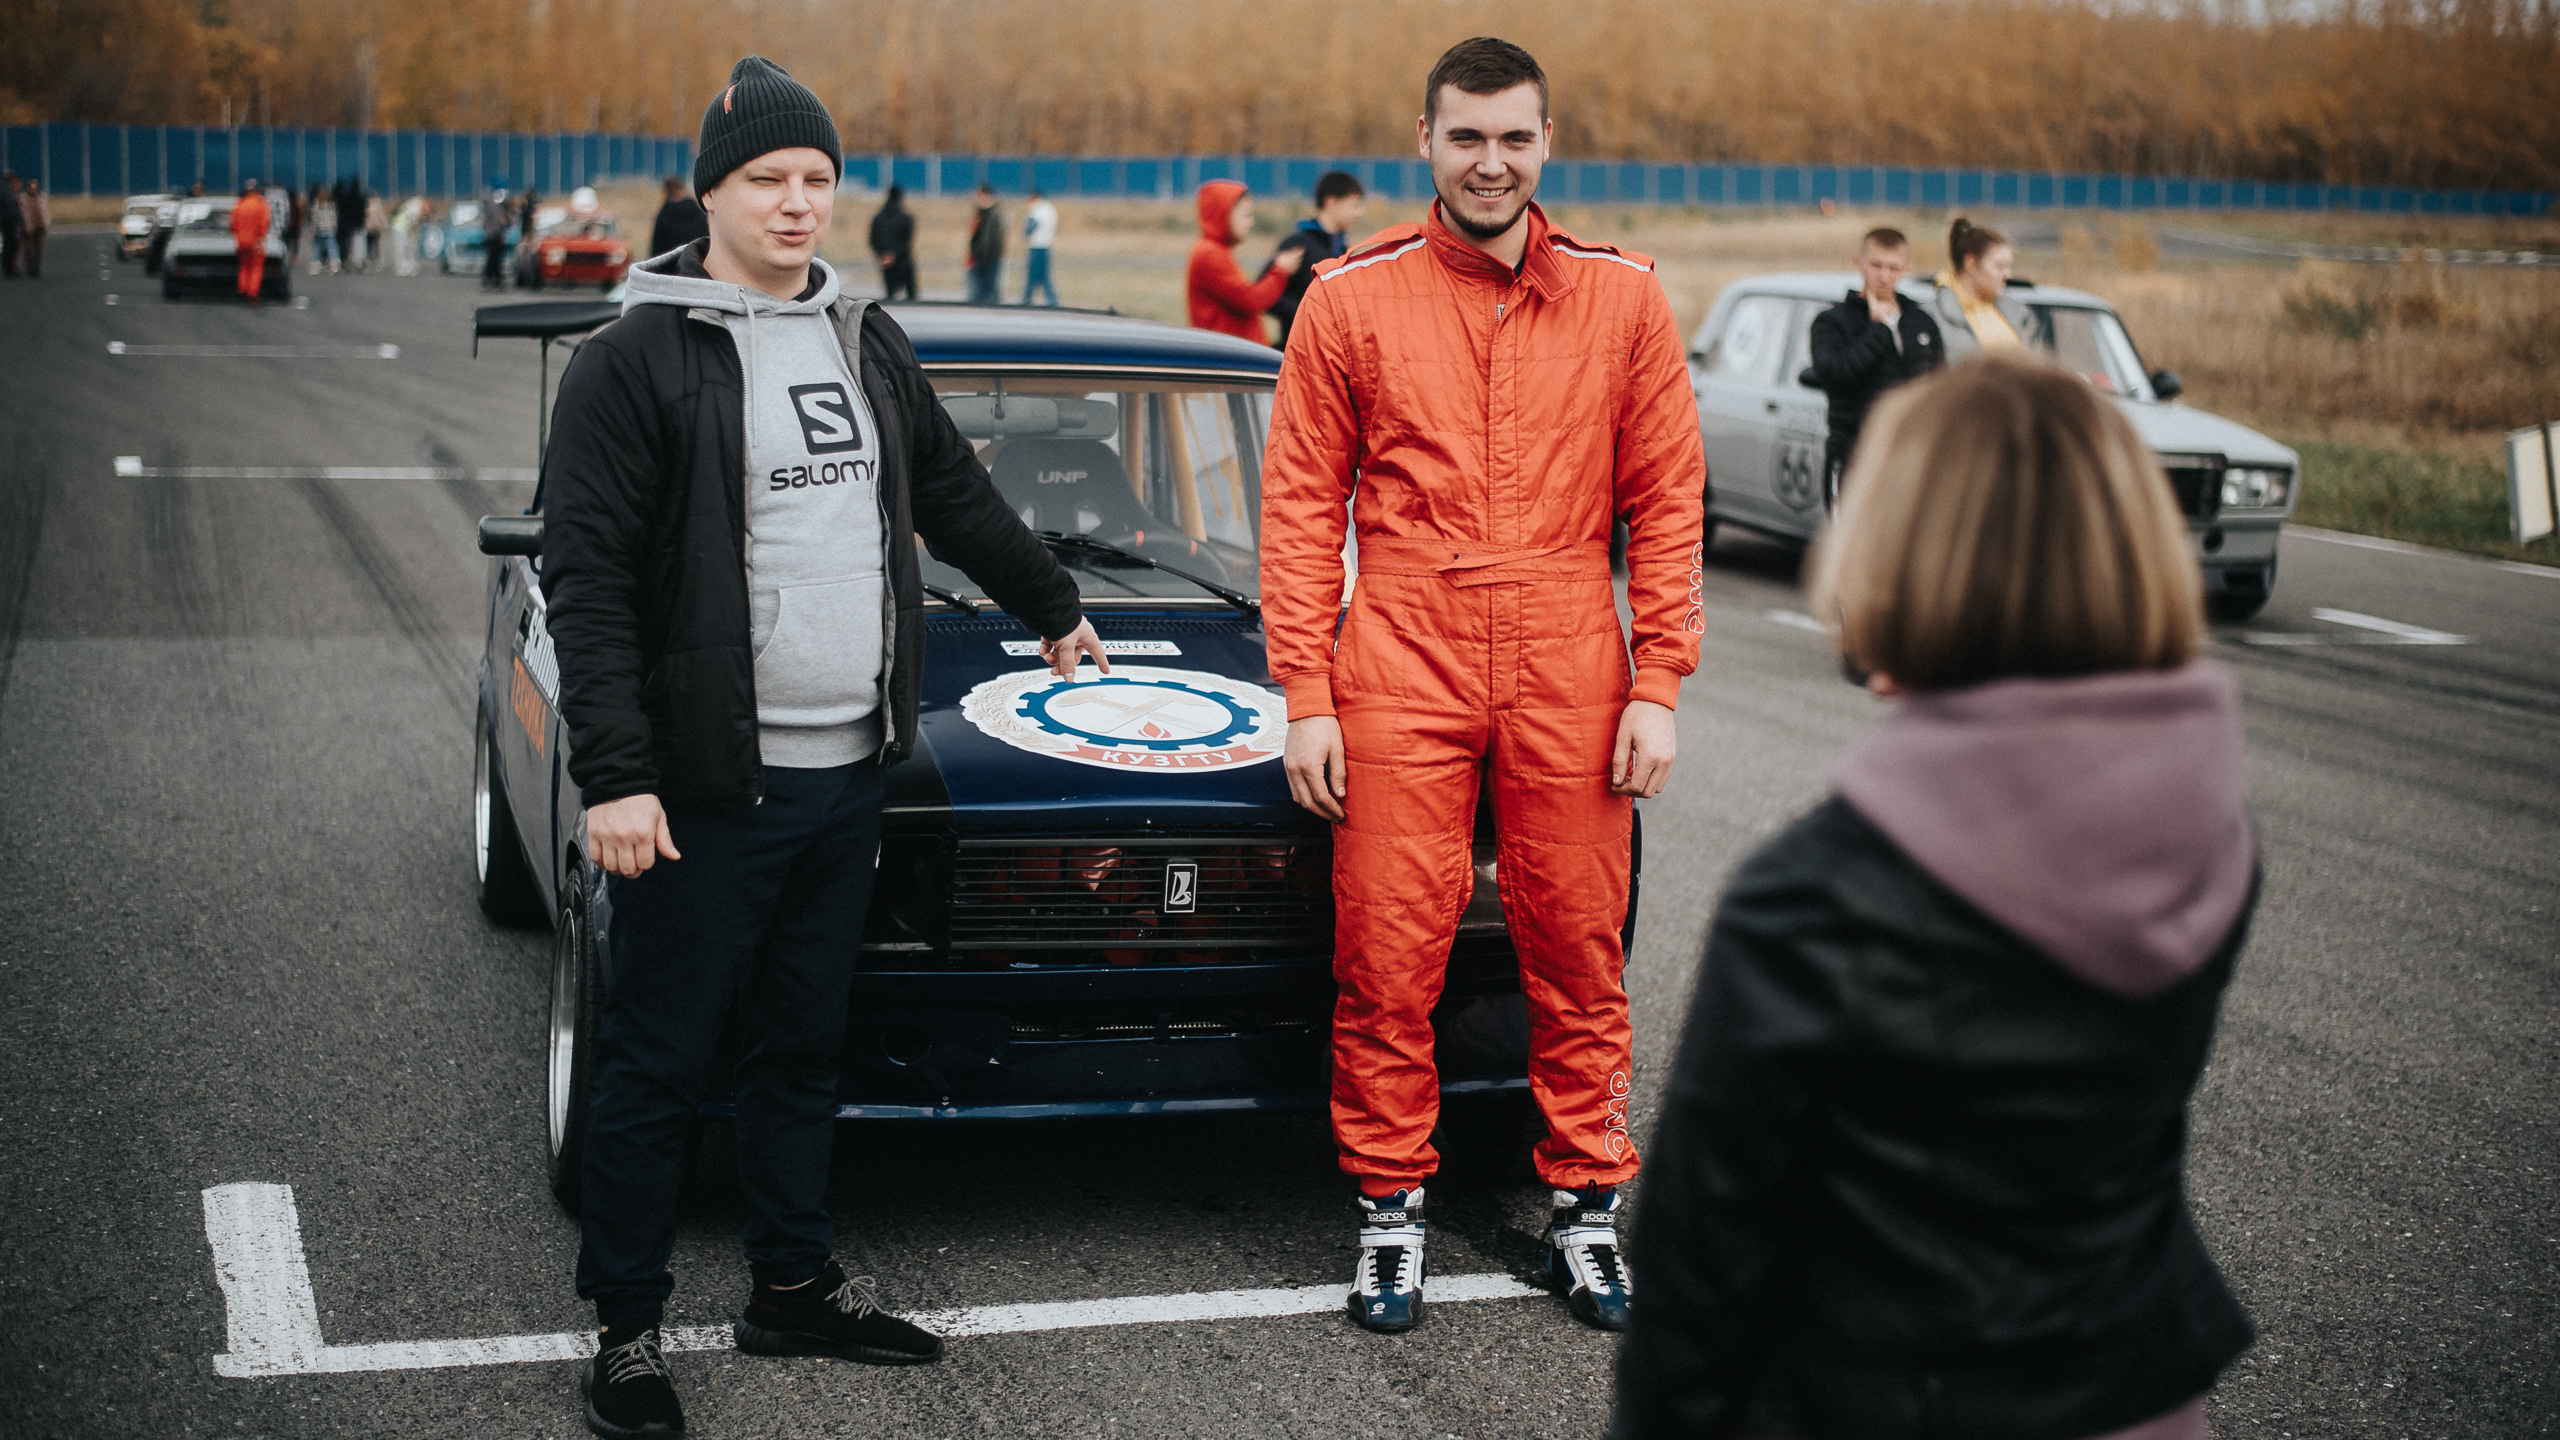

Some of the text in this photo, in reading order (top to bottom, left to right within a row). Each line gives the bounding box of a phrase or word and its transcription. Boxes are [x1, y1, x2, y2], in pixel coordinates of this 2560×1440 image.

[1038, 471, 1088, 483] UNP
[1776, 443, 1812, 497] 66
[512, 655, 547, 761] ТЕХНИКА
[1101, 750, 1233, 767] КУЗГТУ
[1367, 1211, 1408, 1223] sparco
